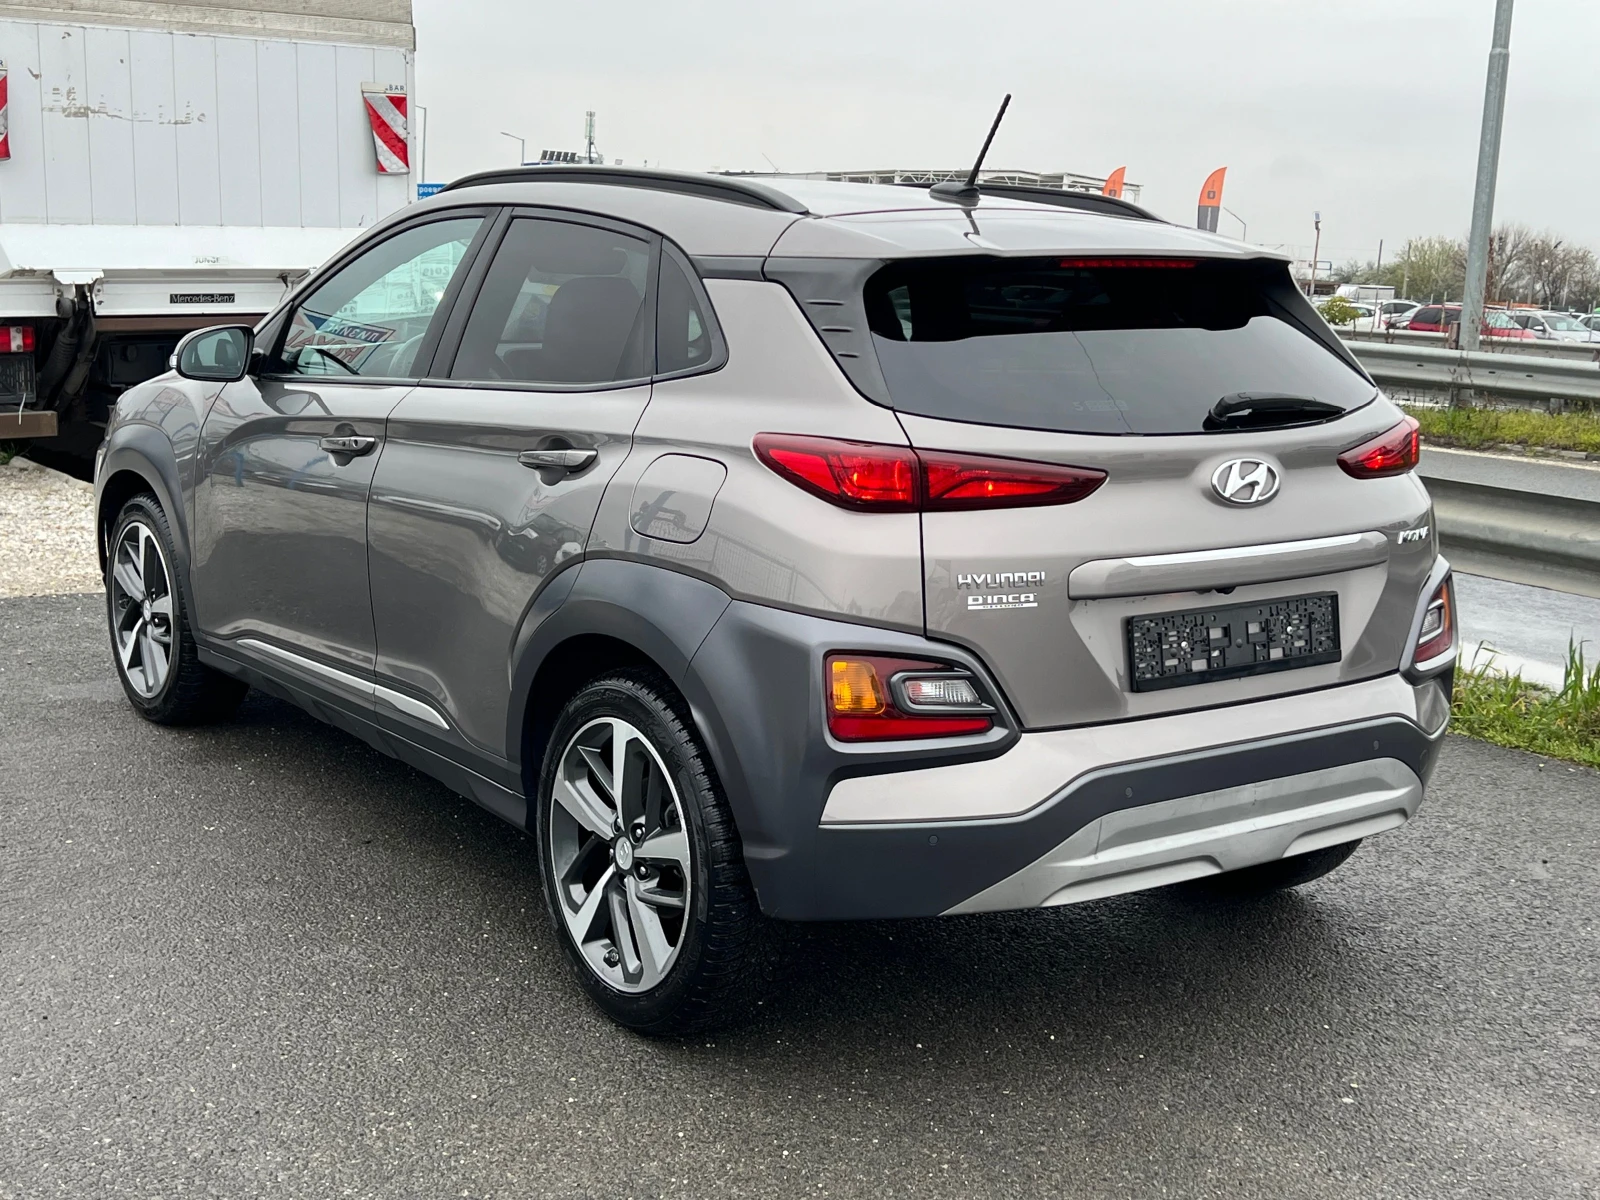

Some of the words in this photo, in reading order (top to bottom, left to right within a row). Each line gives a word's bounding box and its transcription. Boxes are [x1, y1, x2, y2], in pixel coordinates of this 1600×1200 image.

[388, 83, 405, 92] BAR
[171, 293, 235, 303] Mercedes-Benz
[957, 571, 1046, 589] HYUNDAI
